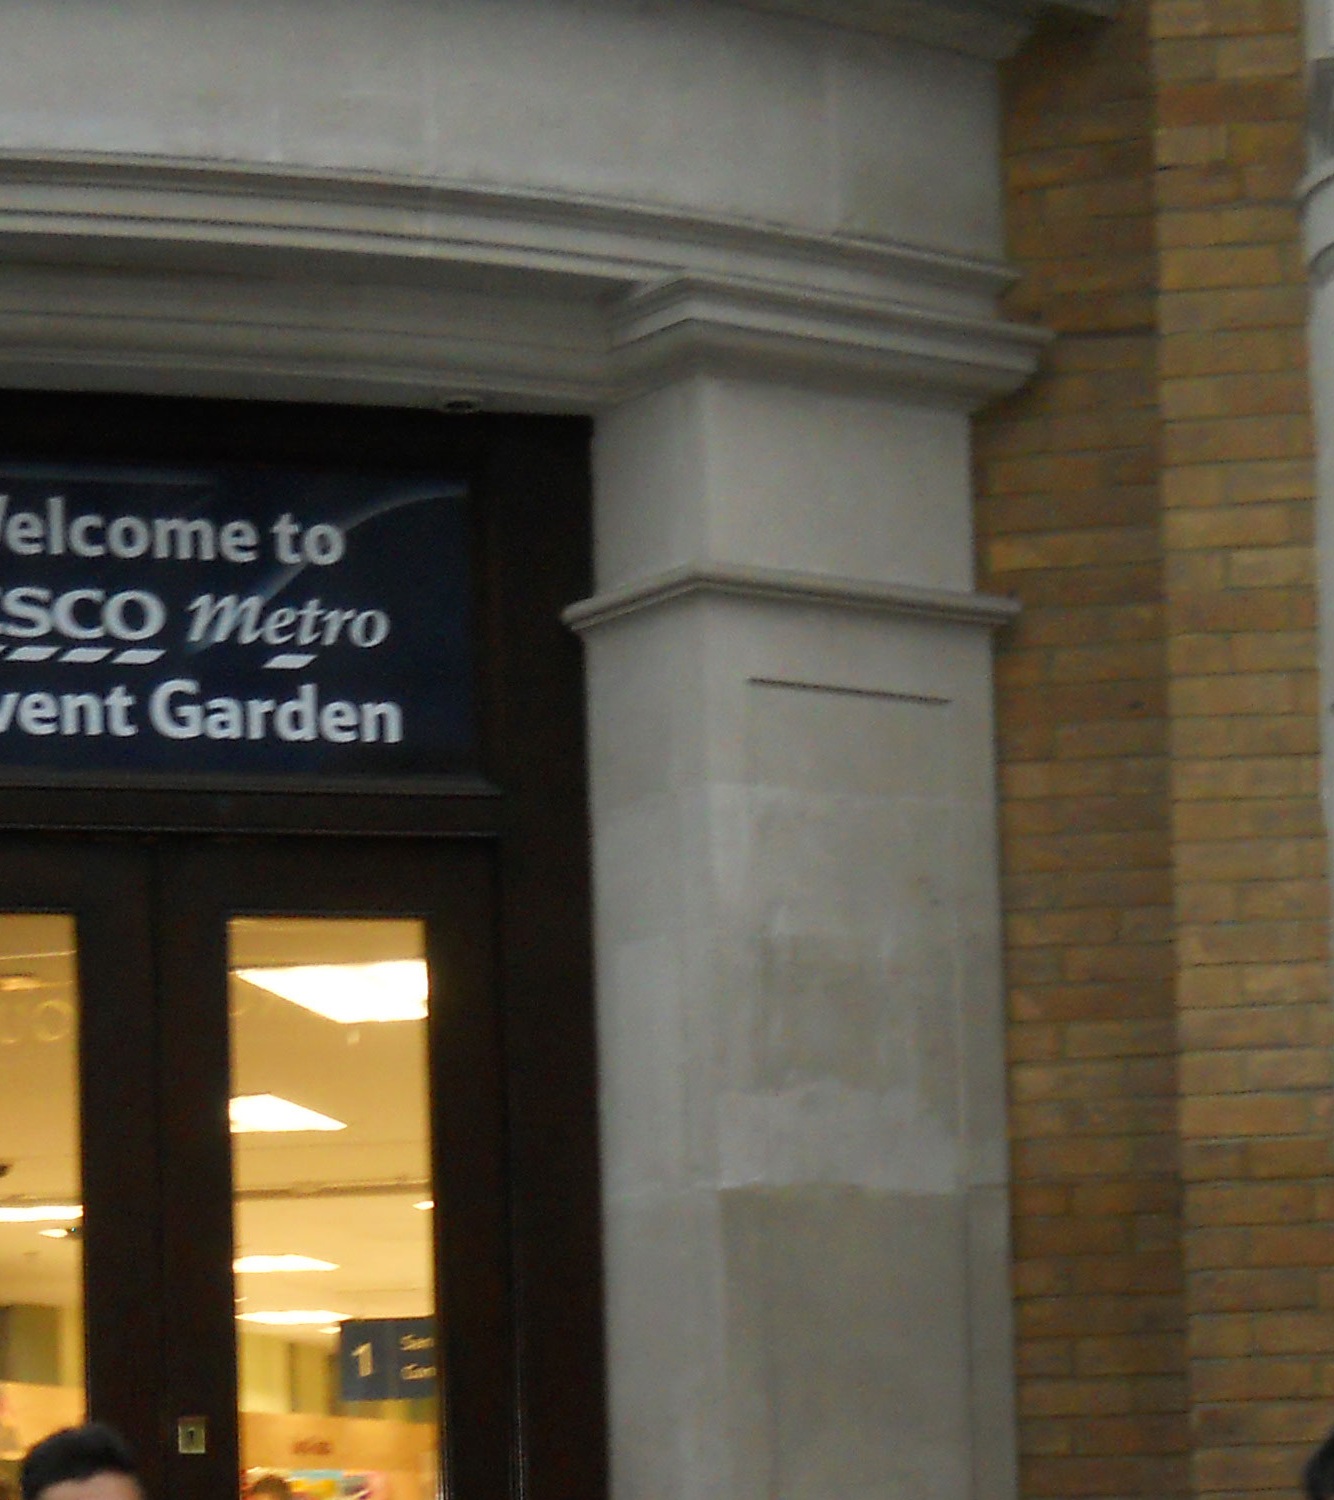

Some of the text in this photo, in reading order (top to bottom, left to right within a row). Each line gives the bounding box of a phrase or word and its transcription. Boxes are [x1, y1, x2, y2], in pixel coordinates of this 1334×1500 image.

[271, 511, 347, 567] to
[148, 678, 404, 745] Garden
[351, 1341, 374, 1378] 1
